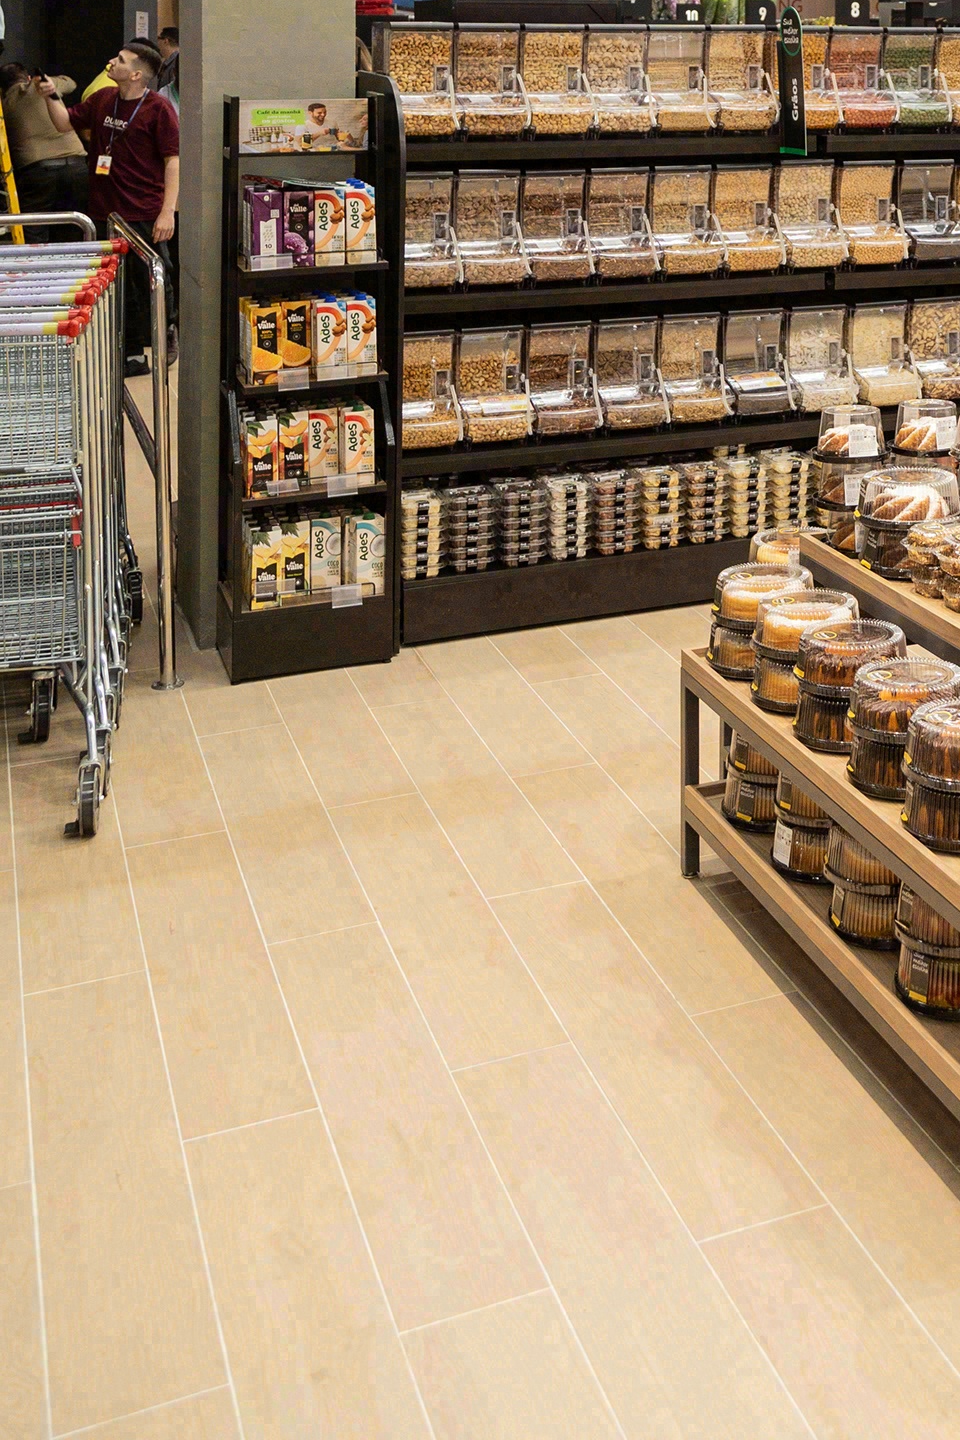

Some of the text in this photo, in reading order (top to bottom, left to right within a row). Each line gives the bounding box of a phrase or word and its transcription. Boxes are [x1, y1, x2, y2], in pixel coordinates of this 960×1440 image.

[685, 9, 699, 21] 10
[758, 6, 767, 21] 9
[850, 1, 860, 18] 8
[782, 18, 793, 26] Sua
[783, 36, 799, 45] escolha
[791, 78, 799, 121] Grãos
[289, 205, 308, 213] Valle
[350, 200, 360, 229] AdeS
[318, 201, 328, 231] AdeS
[287, 315, 305, 323] Valle
[257, 322, 276, 330] Valle
[320, 315, 330, 344] AdeS
[350, 312, 360, 341] AdeS
[311, 420, 321, 450] AdeS
[348, 422, 358, 452] AdeS
[285, 453, 303, 462] Valle
[253, 464, 273, 472] Valle
[314, 529, 324, 559] AdeS
[359, 532, 369, 561] AdeS
[285, 563, 304, 572] Valle
[371, 561, 384, 569] COCO
[257, 574, 276, 582] Valle
